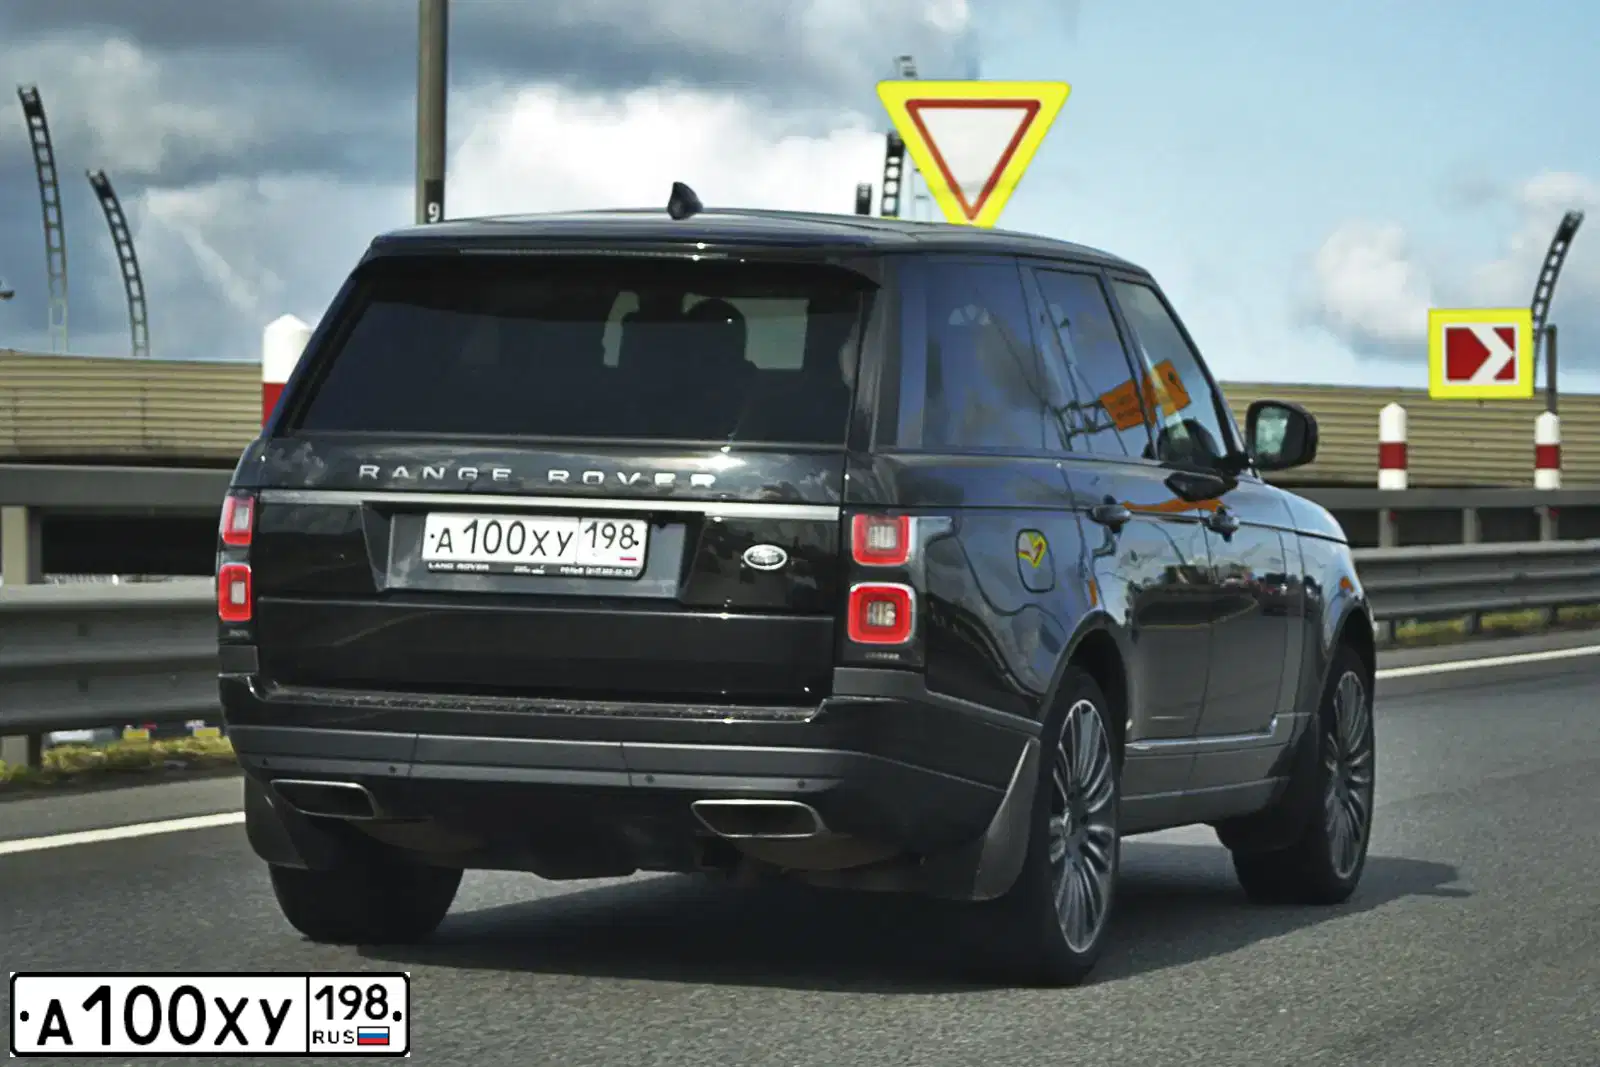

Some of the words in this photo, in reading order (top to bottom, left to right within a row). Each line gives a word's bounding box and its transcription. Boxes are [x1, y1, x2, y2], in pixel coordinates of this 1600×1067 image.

[427, 202, 440, 224] 9
[358, 464, 513, 481] RANGE
[547, 470, 717, 487] ROVER
[584, 521, 635, 550] 198
